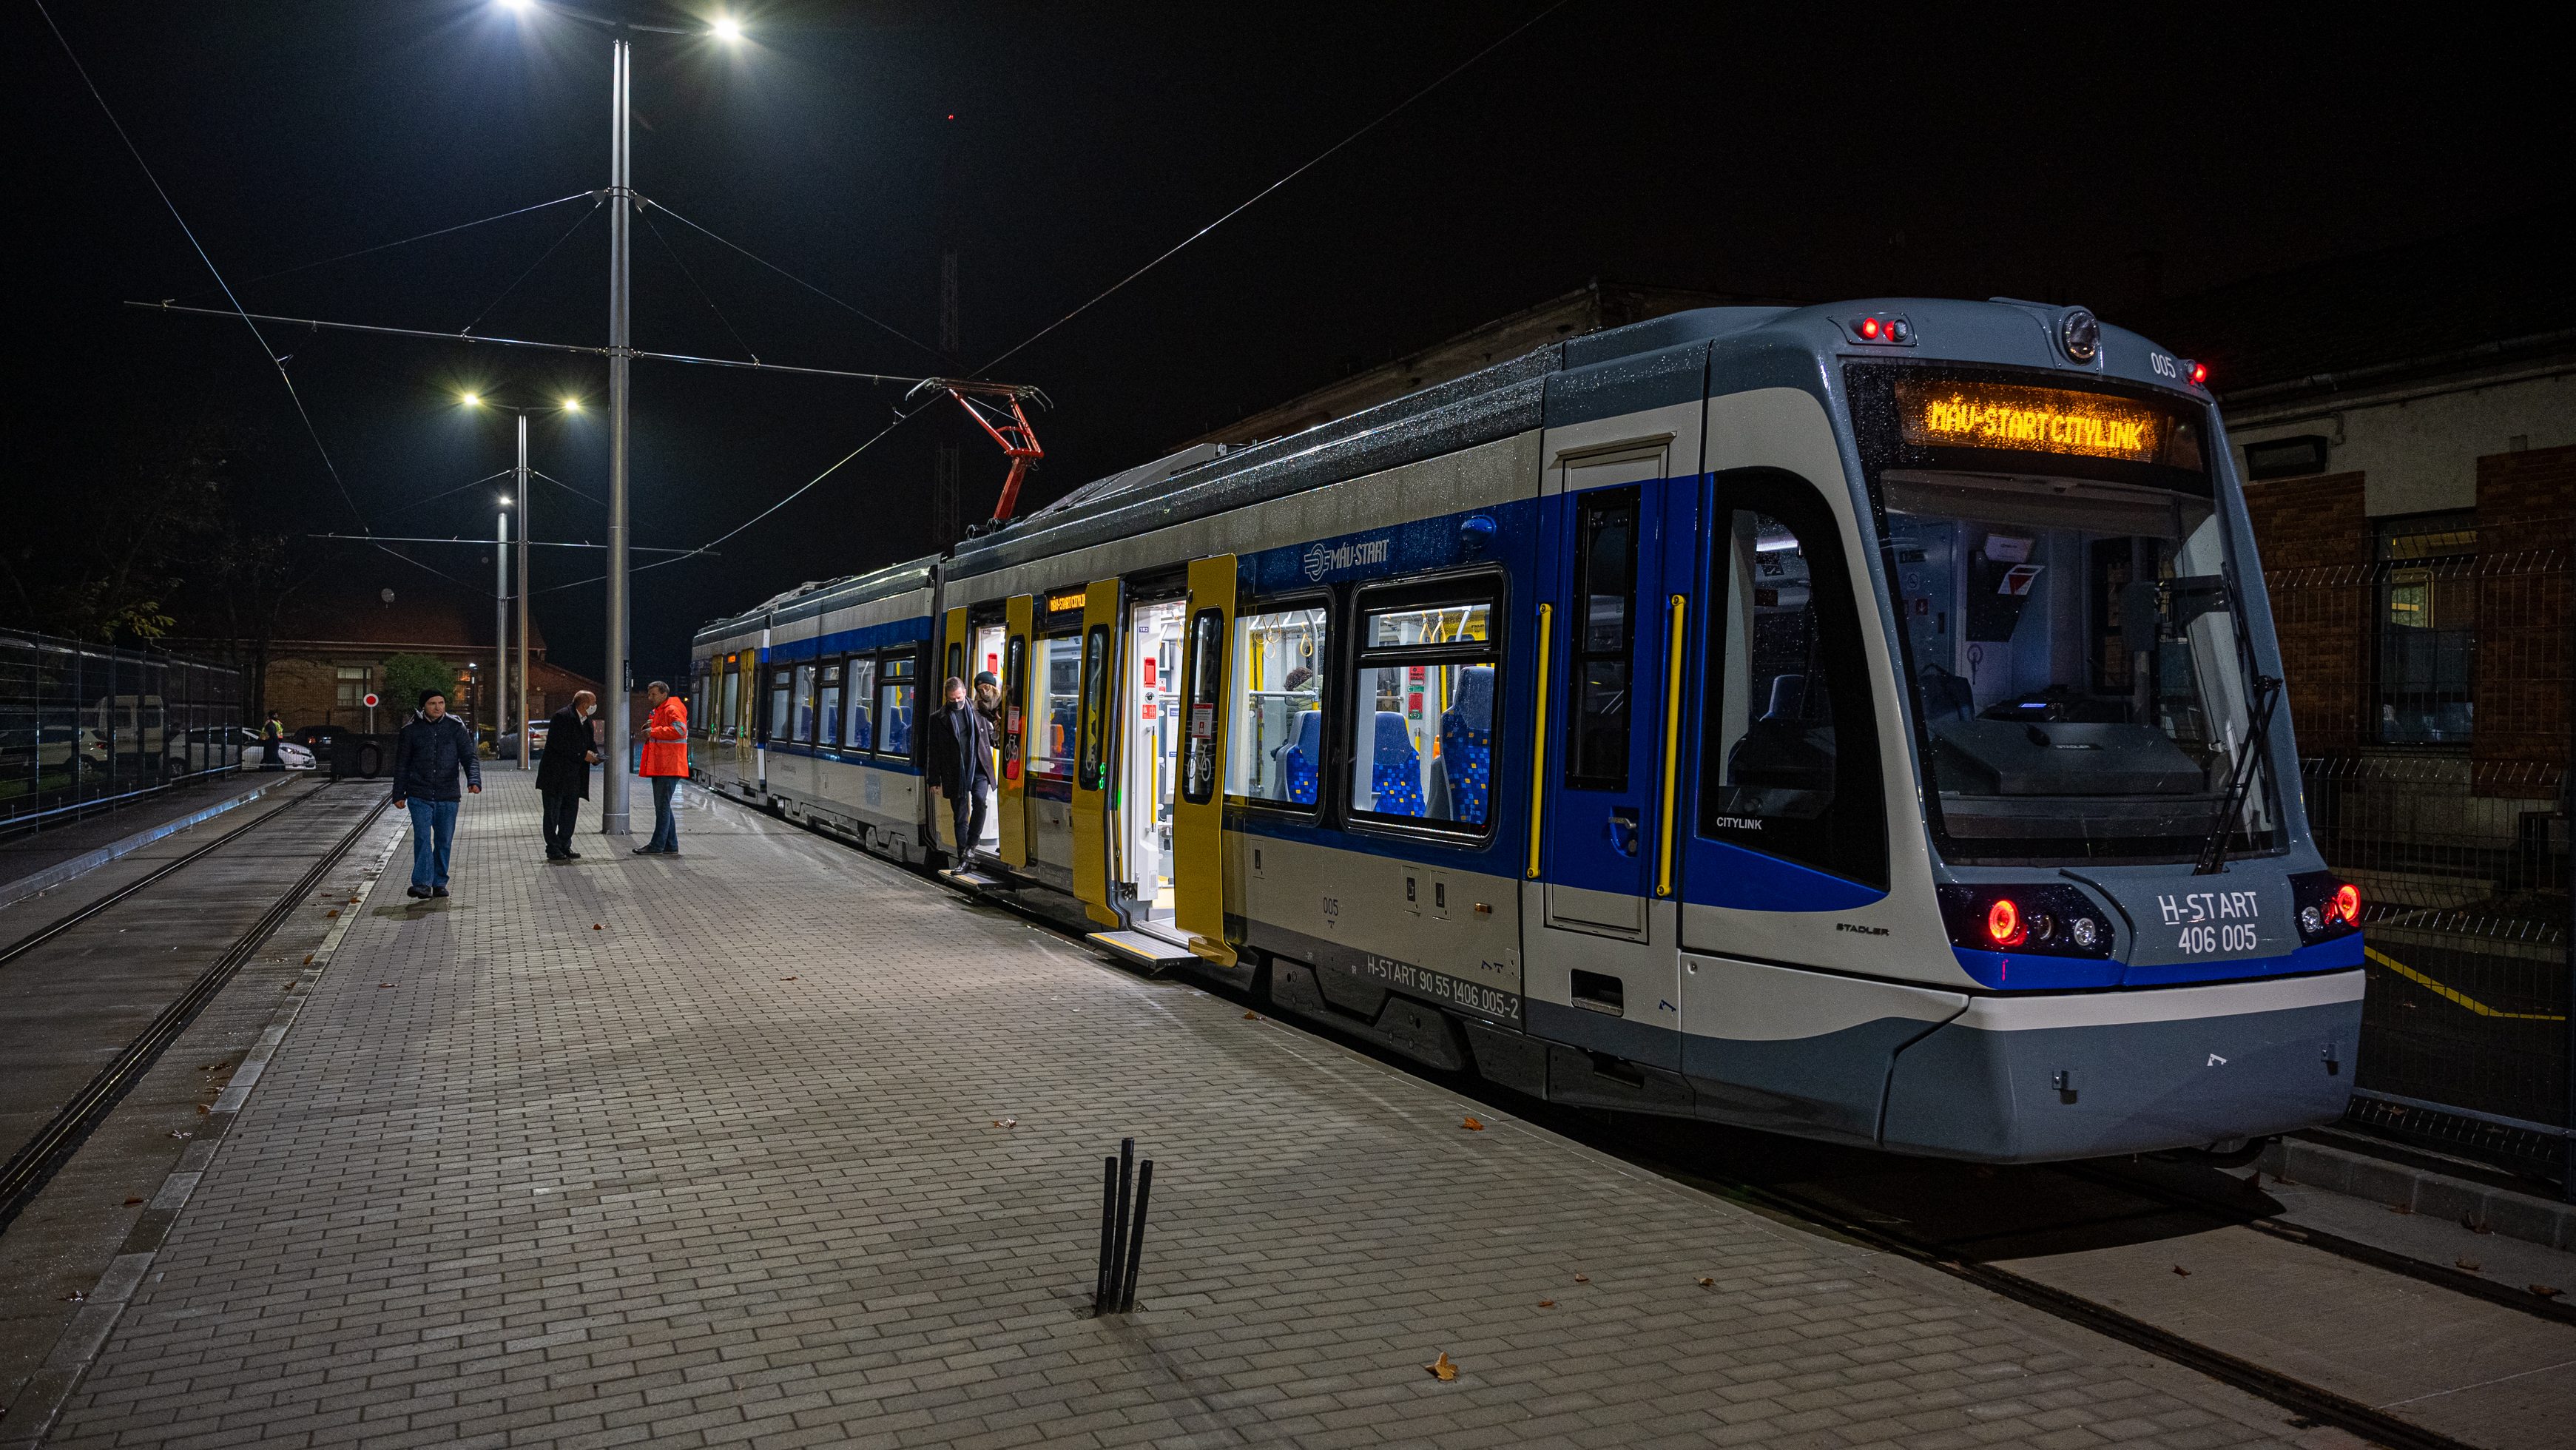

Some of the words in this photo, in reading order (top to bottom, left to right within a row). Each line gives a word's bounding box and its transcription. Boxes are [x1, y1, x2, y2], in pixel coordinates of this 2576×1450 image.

[2151, 352, 2176, 379] 005
[1930, 394, 2049, 441] MÁV-START
[2051, 414, 2144, 451] CITYLINK
[1716, 817, 1762, 830] CITYLINK
[1324, 897, 1339, 916] 005
[2157, 891, 2259, 925] H-START
[1836, 923, 1889, 937] STADLER
[2178, 926, 2216, 954] 406
[2222, 923, 2256, 951] 005
[1367, 954, 1416, 987] H-START
[1420, 971, 1433, 992] 90
[1435, 975, 1450, 997] 55
[1453, 980, 1479, 1006] 1406
[1482, 989, 1519, 1019] 005-2
